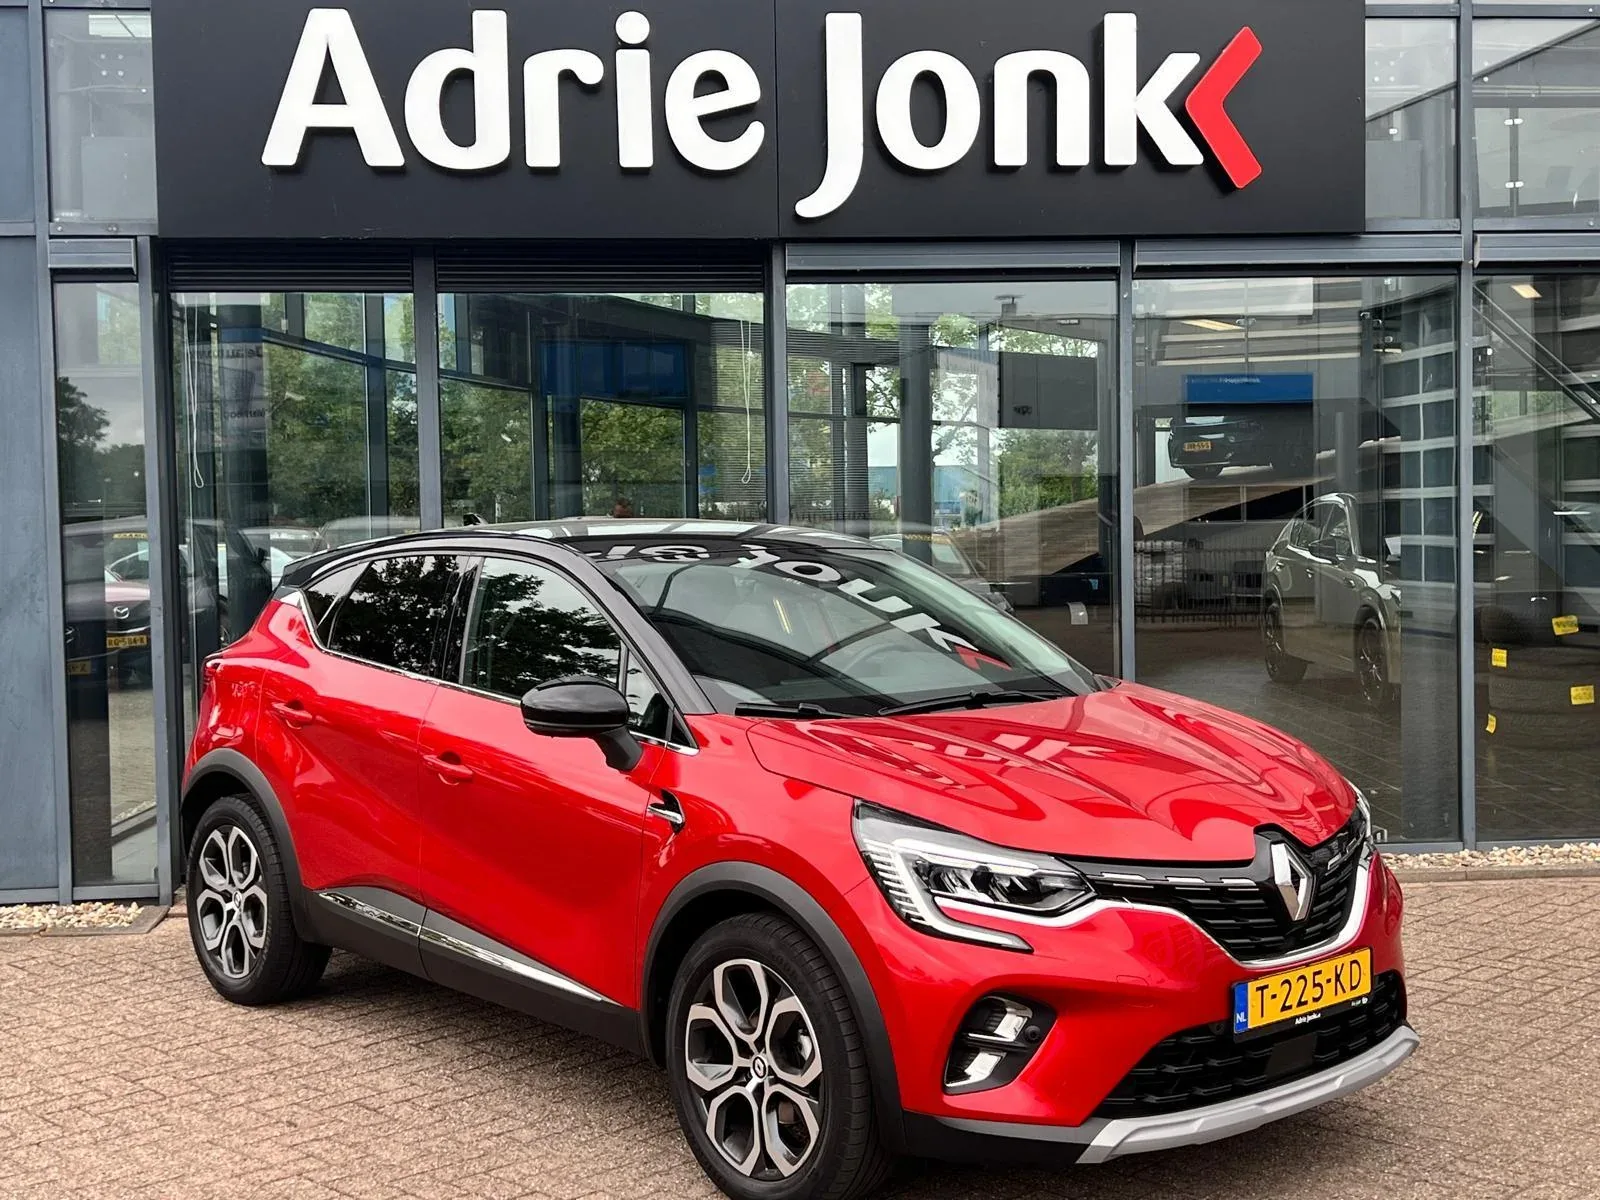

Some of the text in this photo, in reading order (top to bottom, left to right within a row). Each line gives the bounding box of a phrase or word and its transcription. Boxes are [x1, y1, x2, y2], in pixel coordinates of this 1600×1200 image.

[261, 8, 1204, 219] Adrie Jonk
[1236, 1011, 1247, 1023] NL
[1255, 959, 1361, 1018] T-225-KD
